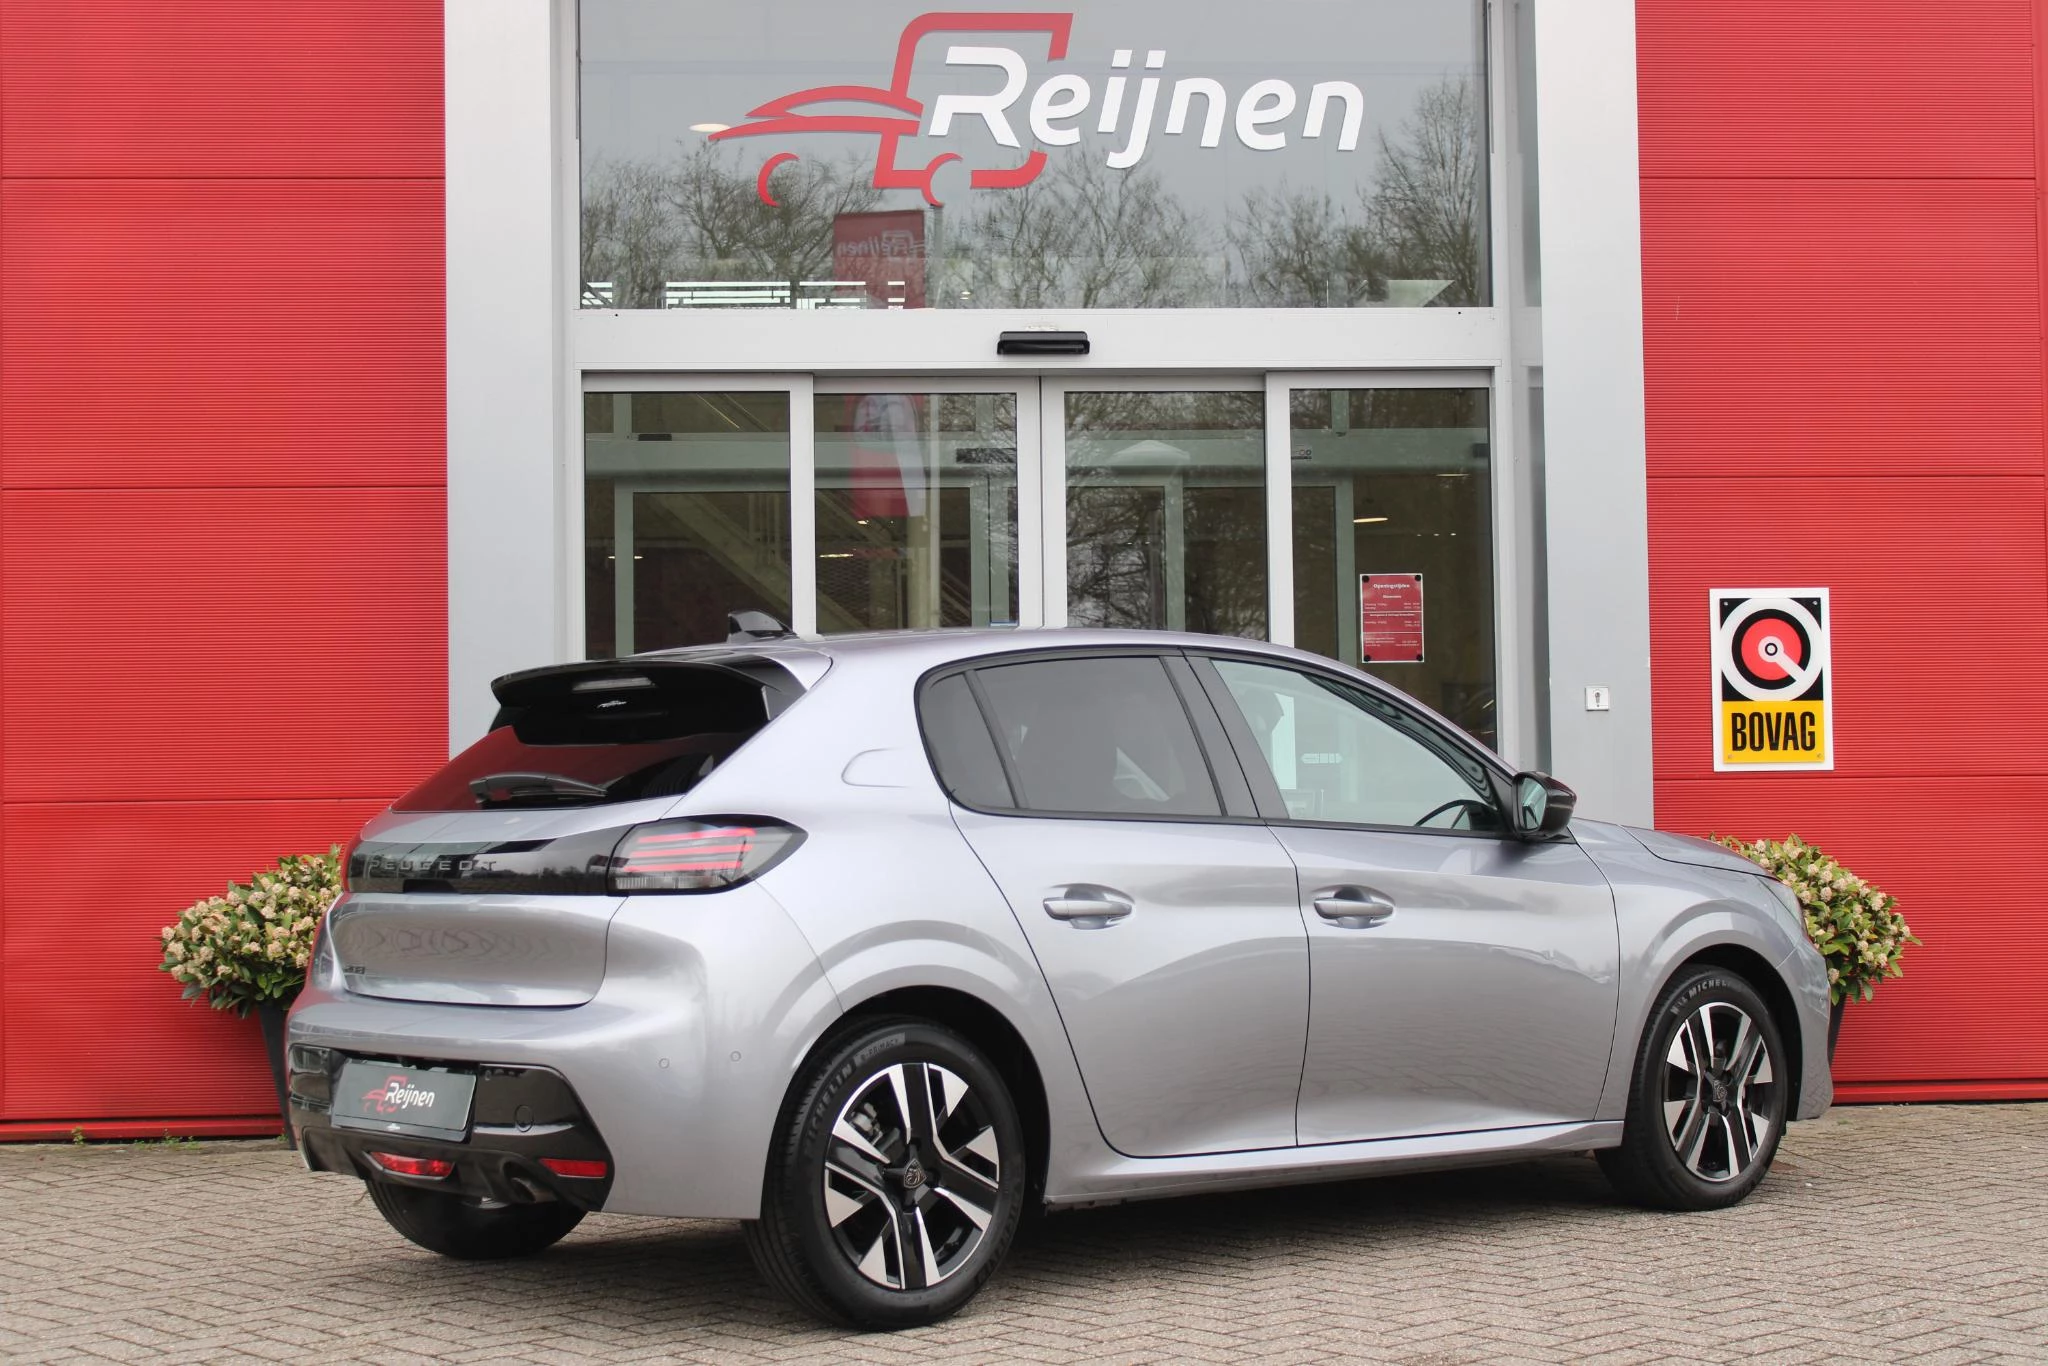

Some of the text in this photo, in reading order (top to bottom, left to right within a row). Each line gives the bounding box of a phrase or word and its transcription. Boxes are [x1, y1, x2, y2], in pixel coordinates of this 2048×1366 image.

[926, 46, 1365, 169] Reijnen
[1731, 711, 1816, 752] BOVAG
[368, 858, 497, 873] PEUGEOT
[384, 1081, 436, 1110] Reijnen
